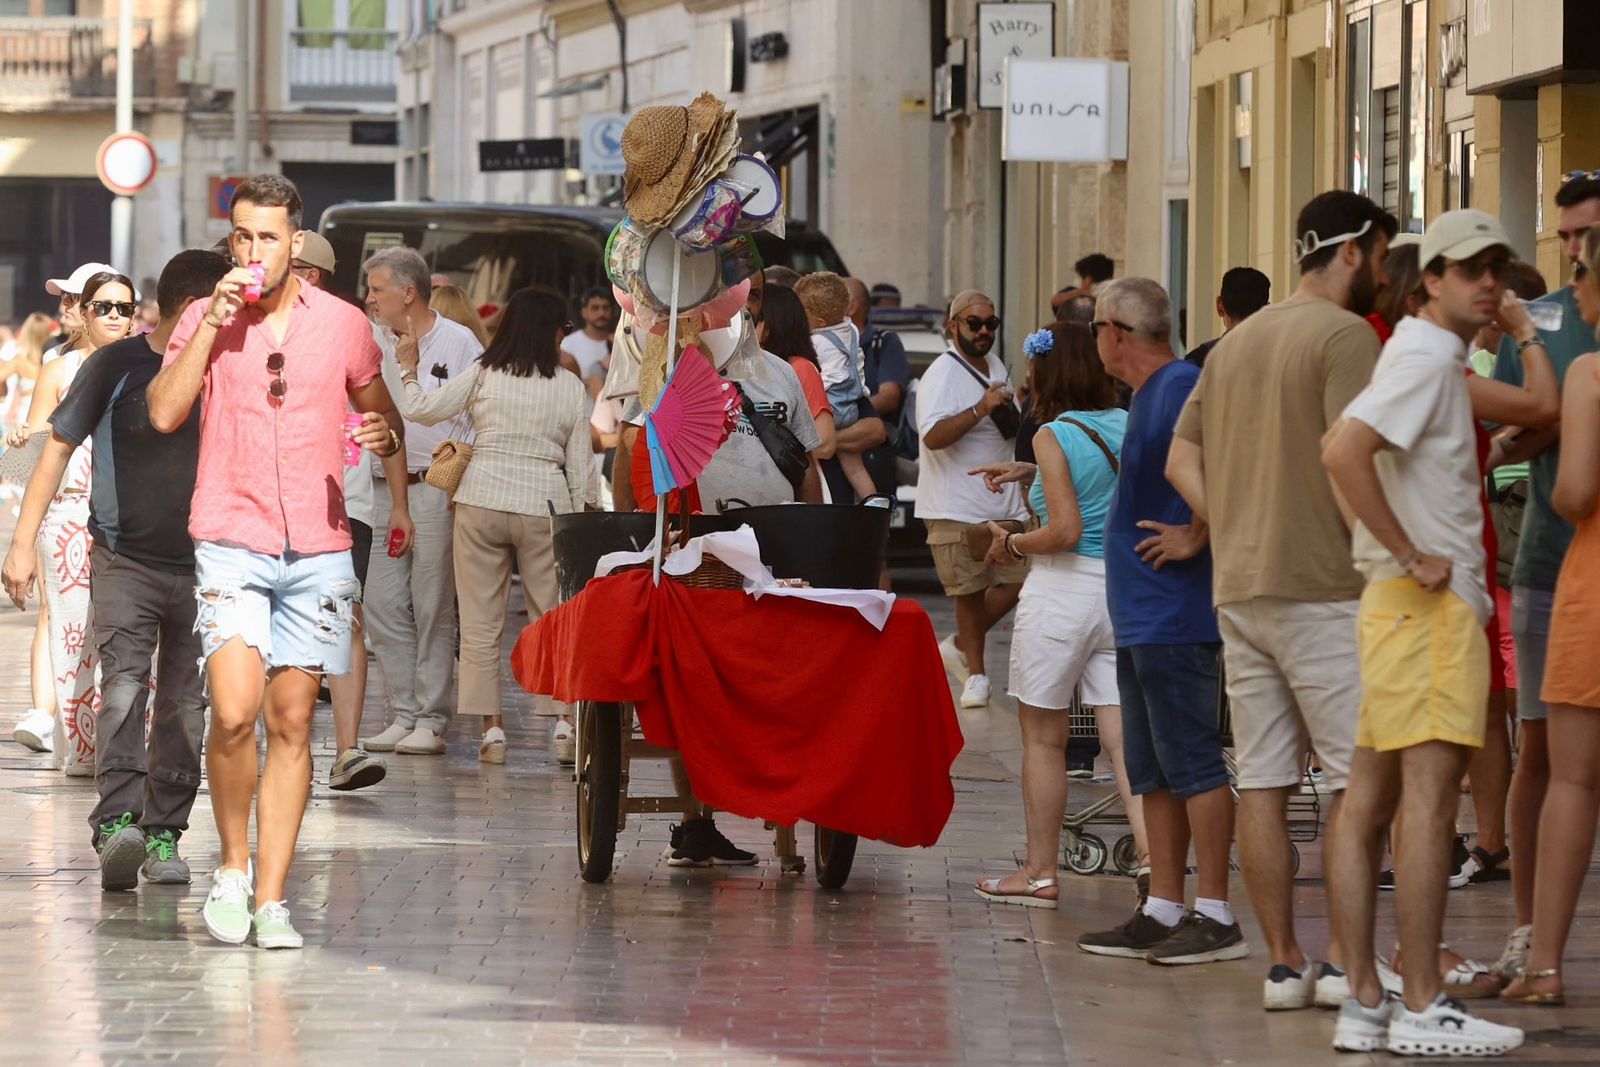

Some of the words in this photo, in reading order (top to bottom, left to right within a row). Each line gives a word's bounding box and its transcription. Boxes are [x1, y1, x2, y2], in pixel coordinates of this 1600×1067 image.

[988, 19, 1043, 37] Barry
[1008, 44, 1023, 58] &
[1011, 103, 1101, 117] UNISA
